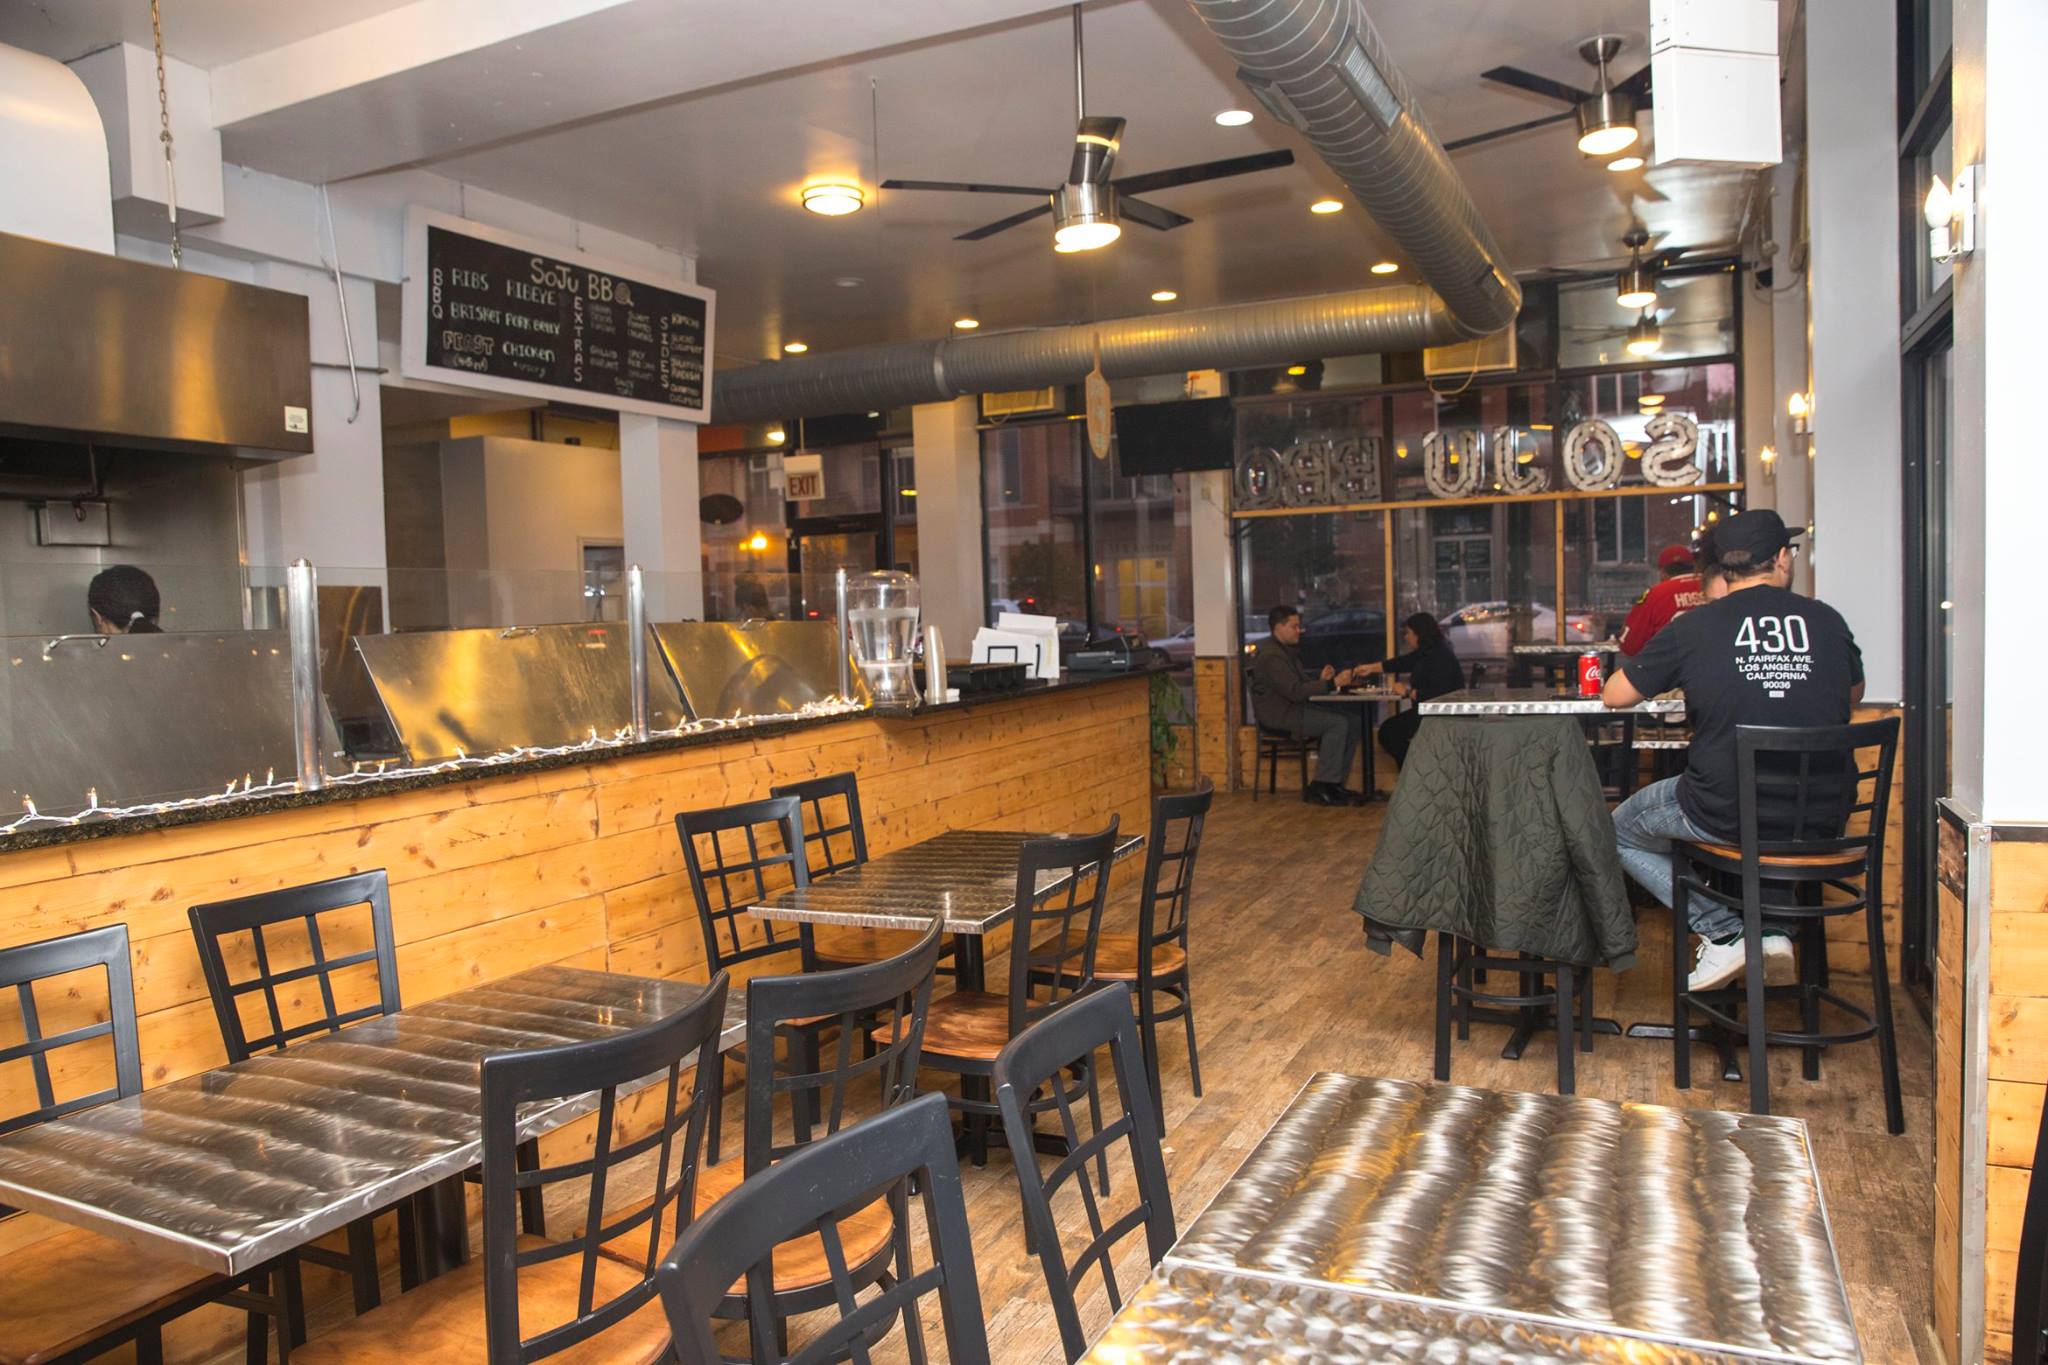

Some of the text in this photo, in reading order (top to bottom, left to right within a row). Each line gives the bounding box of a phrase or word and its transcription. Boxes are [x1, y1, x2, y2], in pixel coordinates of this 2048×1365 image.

[452, 267, 489, 291] RIBS
[506, 279, 557, 306] RIBEYE
[790, 473, 817, 497] EXIT
[1734, 614, 1810, 654] 430
[1735, 654, 1815, 665] N. FAIRFAX AVE.
[1739, 663, 1812, 672] LOS ANGELES,
[1746, 672, 1808, 680] CALIFORNIA
